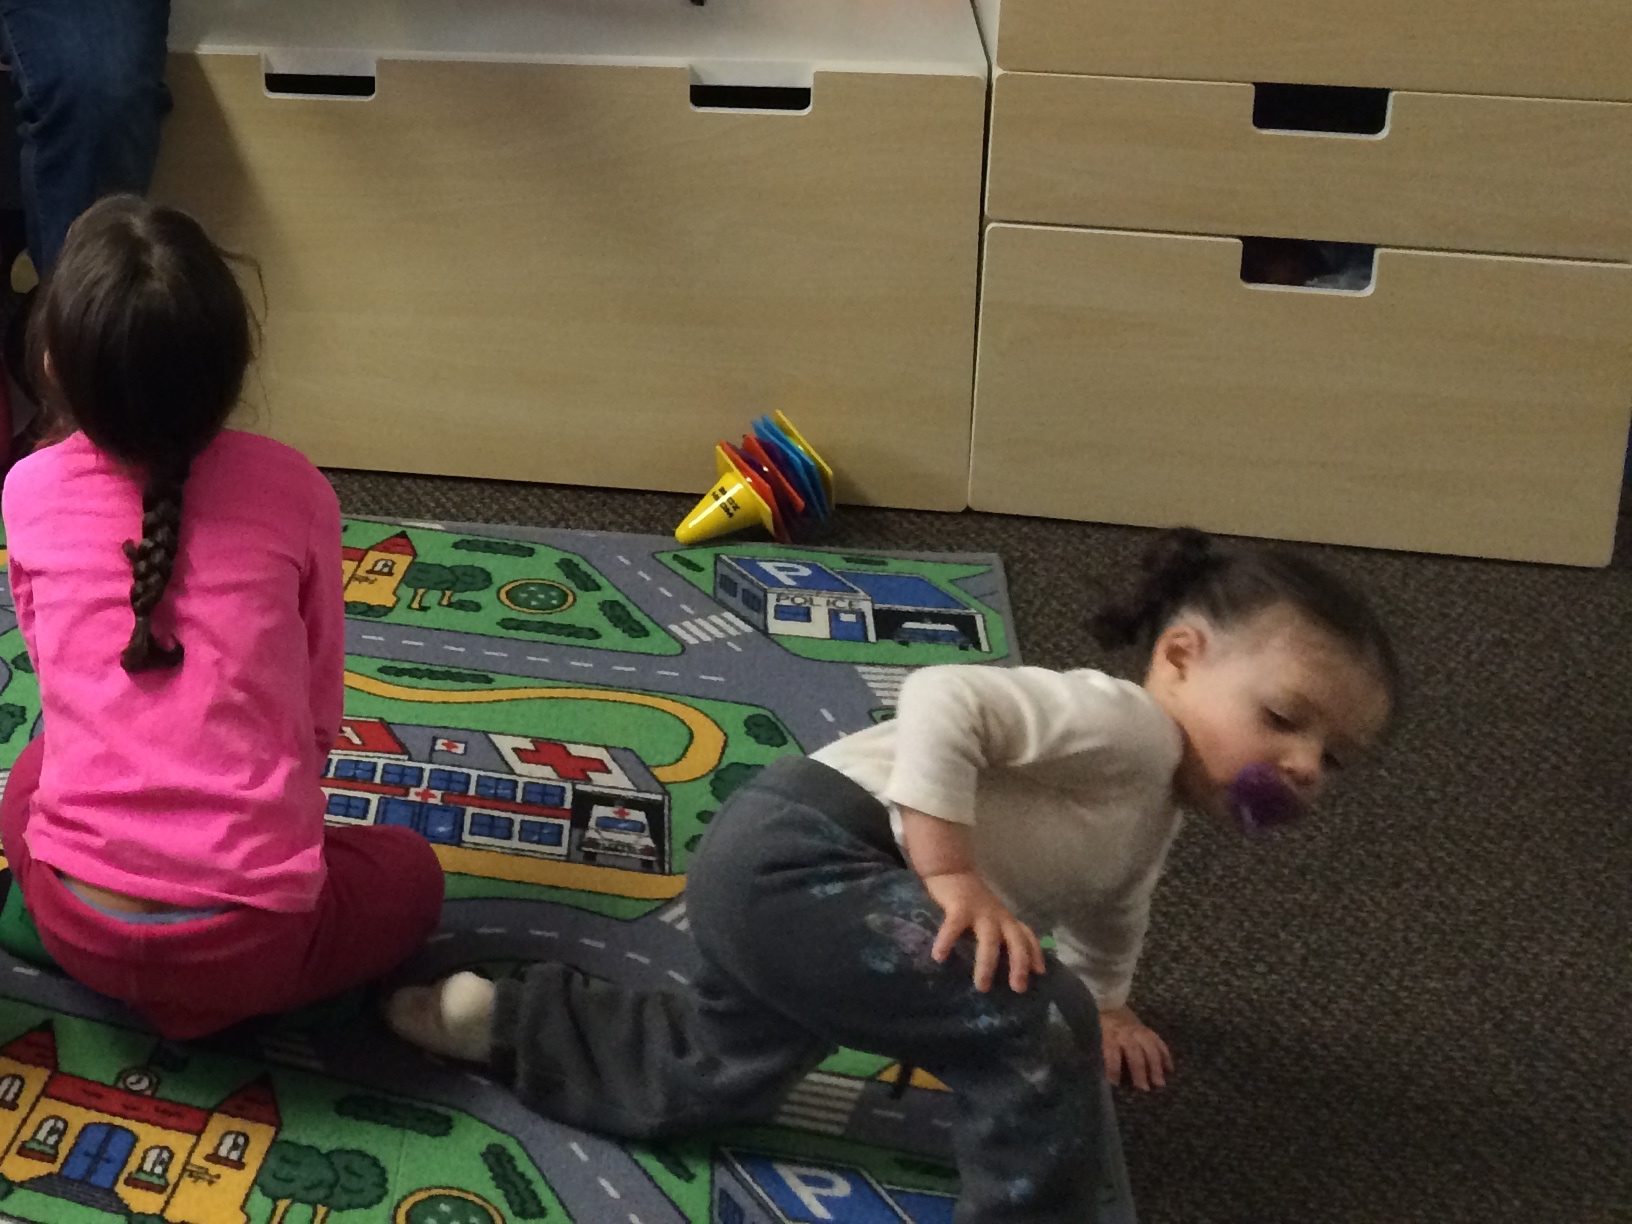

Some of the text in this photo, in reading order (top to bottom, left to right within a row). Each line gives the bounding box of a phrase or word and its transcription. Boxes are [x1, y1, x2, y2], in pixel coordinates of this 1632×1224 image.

[756, 561, 813, 587] P
[775, 592, 859, 609] POLICE
[771, 1162, 852, 1220] P
